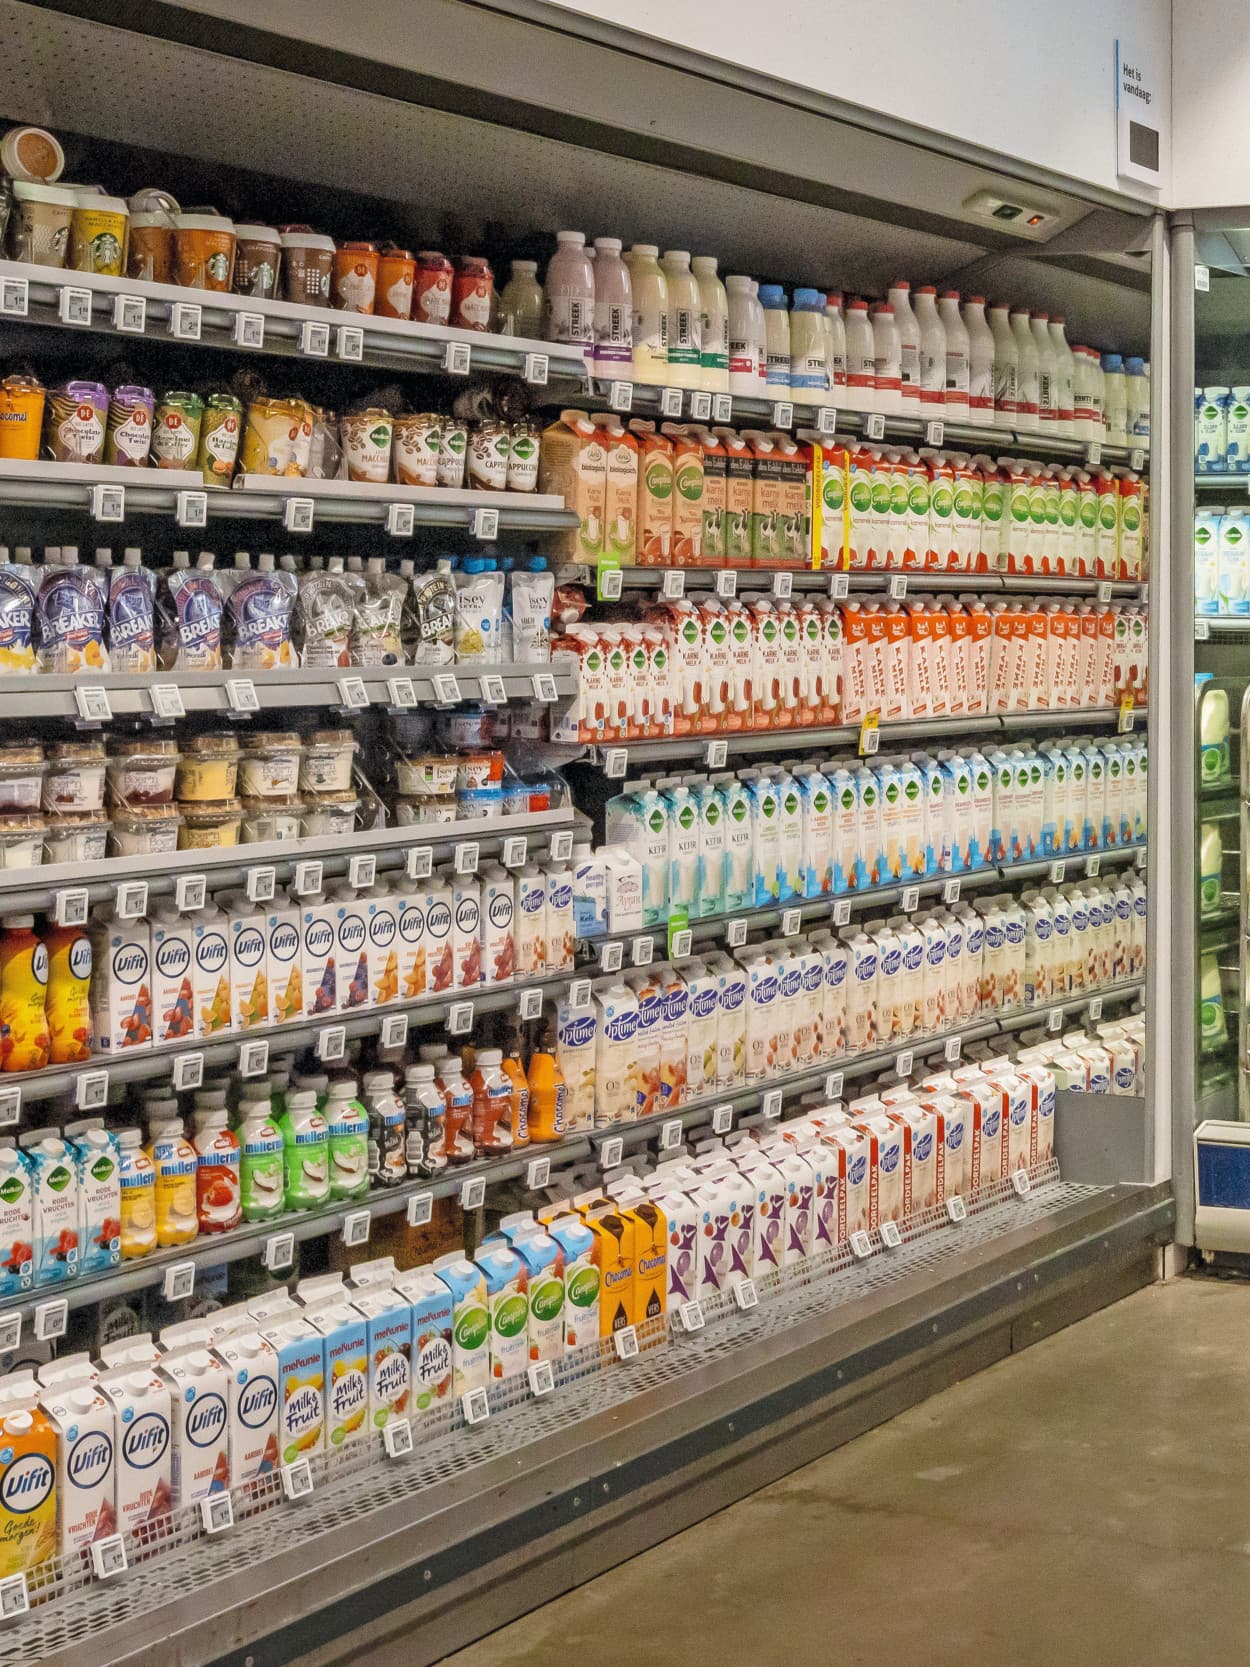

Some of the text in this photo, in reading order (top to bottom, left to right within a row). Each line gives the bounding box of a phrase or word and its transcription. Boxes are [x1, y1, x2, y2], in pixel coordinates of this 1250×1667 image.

[1123, 64, 1142, 81] Het is
[571, 302, 580, 336] STREEK
[612, 308, 620, 342] STREEK
[0, 411, 26, 422] ocomel
[0, 611, 31, 628] AKER
[110, 615, 153, 642] BREAK
[517, 1088, 528, 1140] Chocomel
[553, 1083, 566, 1136] Chocomel
[419, 1357, 449, 1379] Fruit
[376, 1373, 408, 1394] Fruit
[333, 1389, 366, 1413] Fruit
[286, 1406, 320, 1428] Fruit
[4, 1516, 35, 1534] Goede
